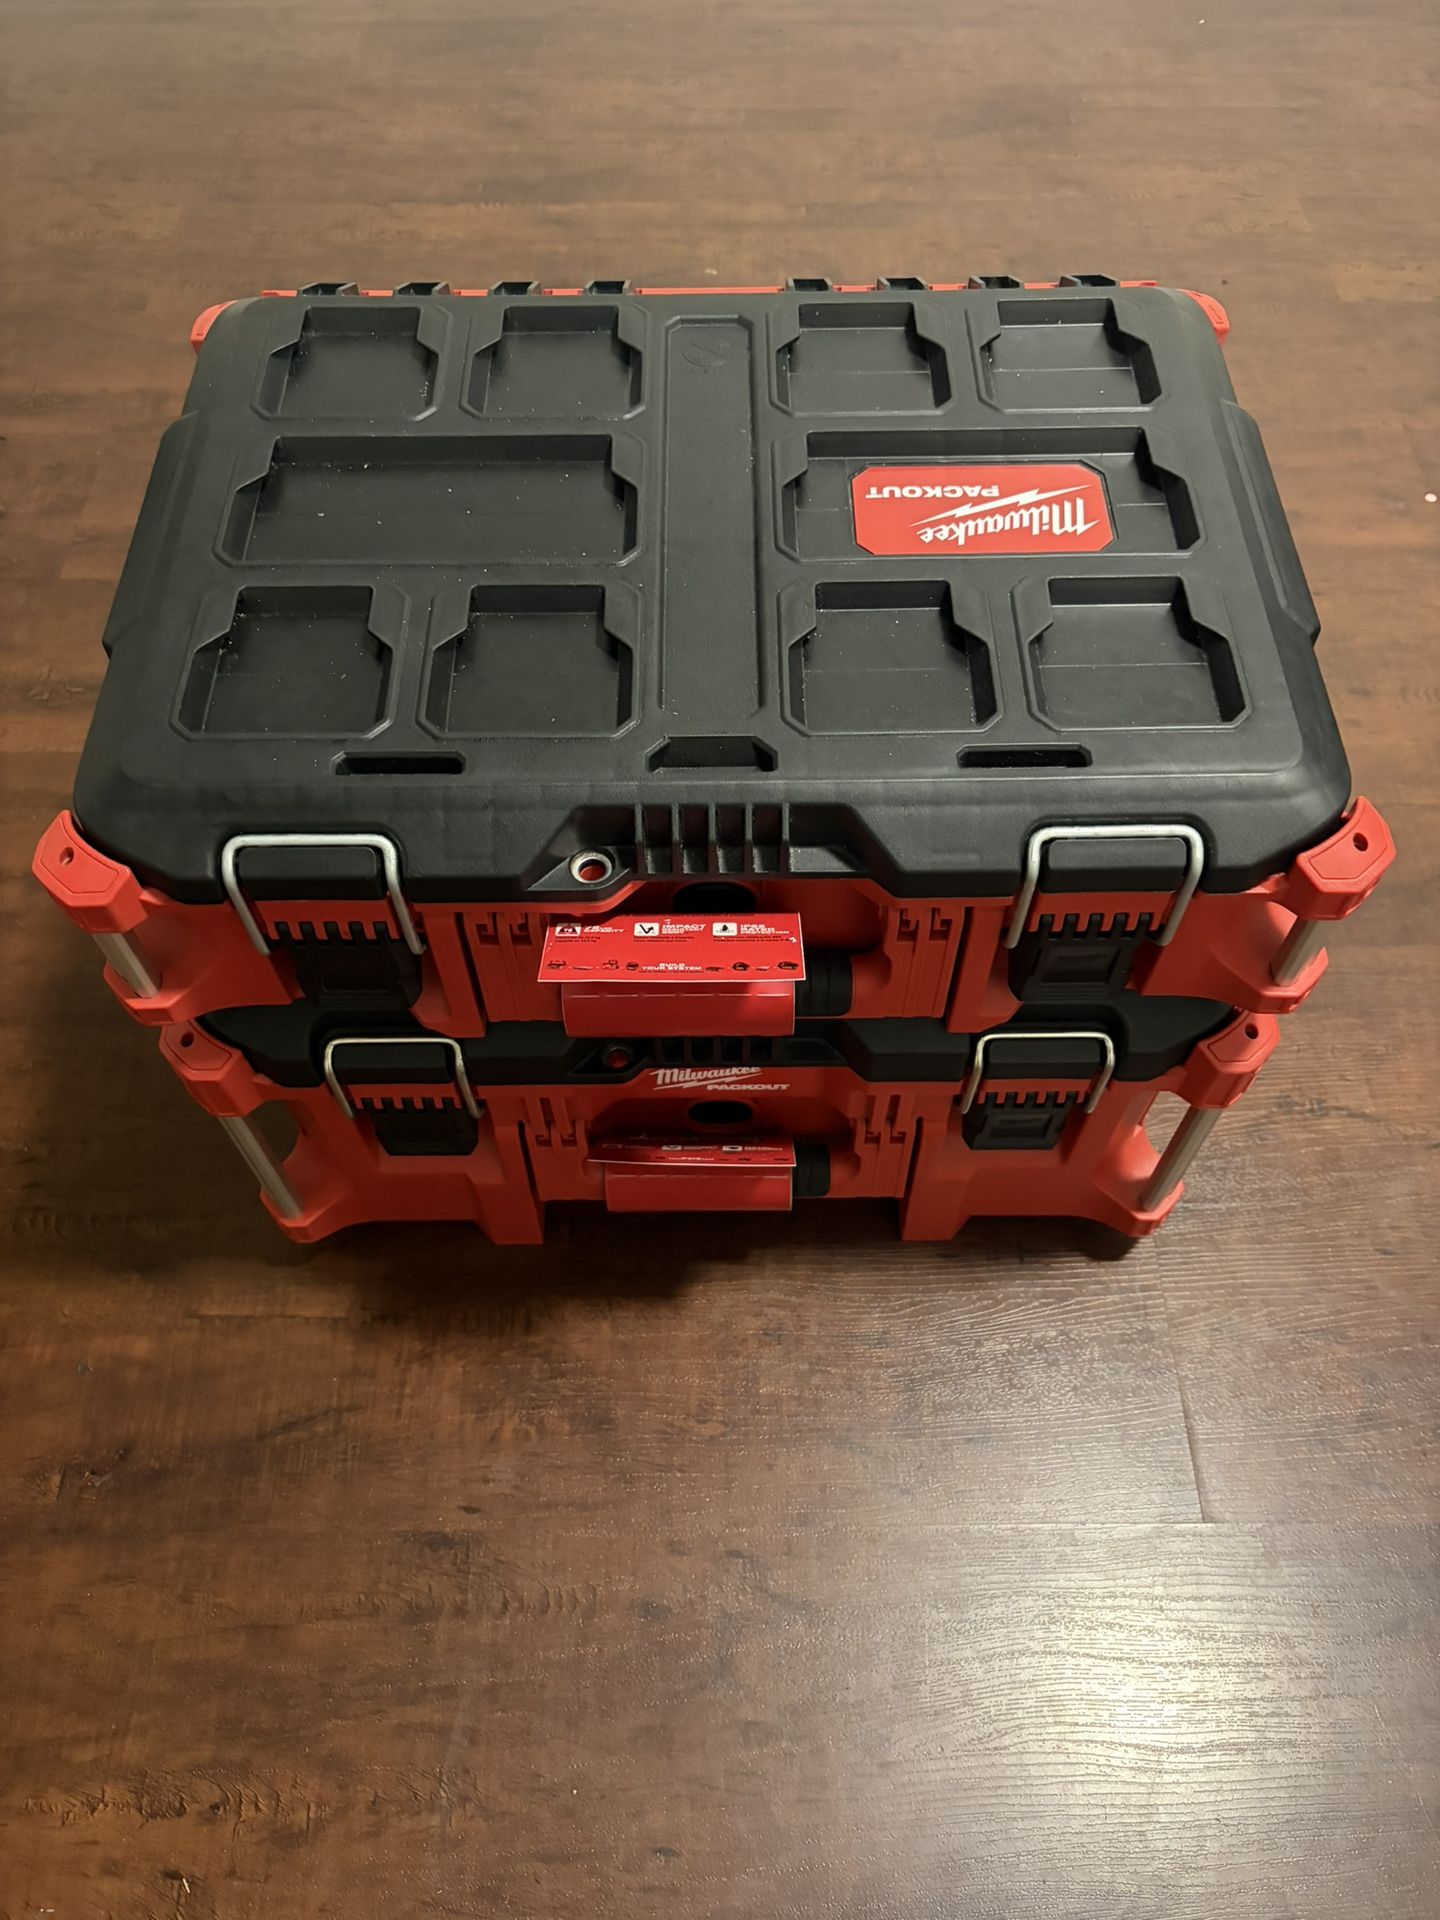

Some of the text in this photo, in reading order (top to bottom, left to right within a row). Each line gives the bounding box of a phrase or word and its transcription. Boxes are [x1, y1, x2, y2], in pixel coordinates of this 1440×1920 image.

[865, 485, 1000, 499] PACKOUT
[916, 497, 1100, 546] Milwaukee
[649, 1066, 762, 1086] Milwaukee
[706, 1083, 790, 1091] PACKOUT
